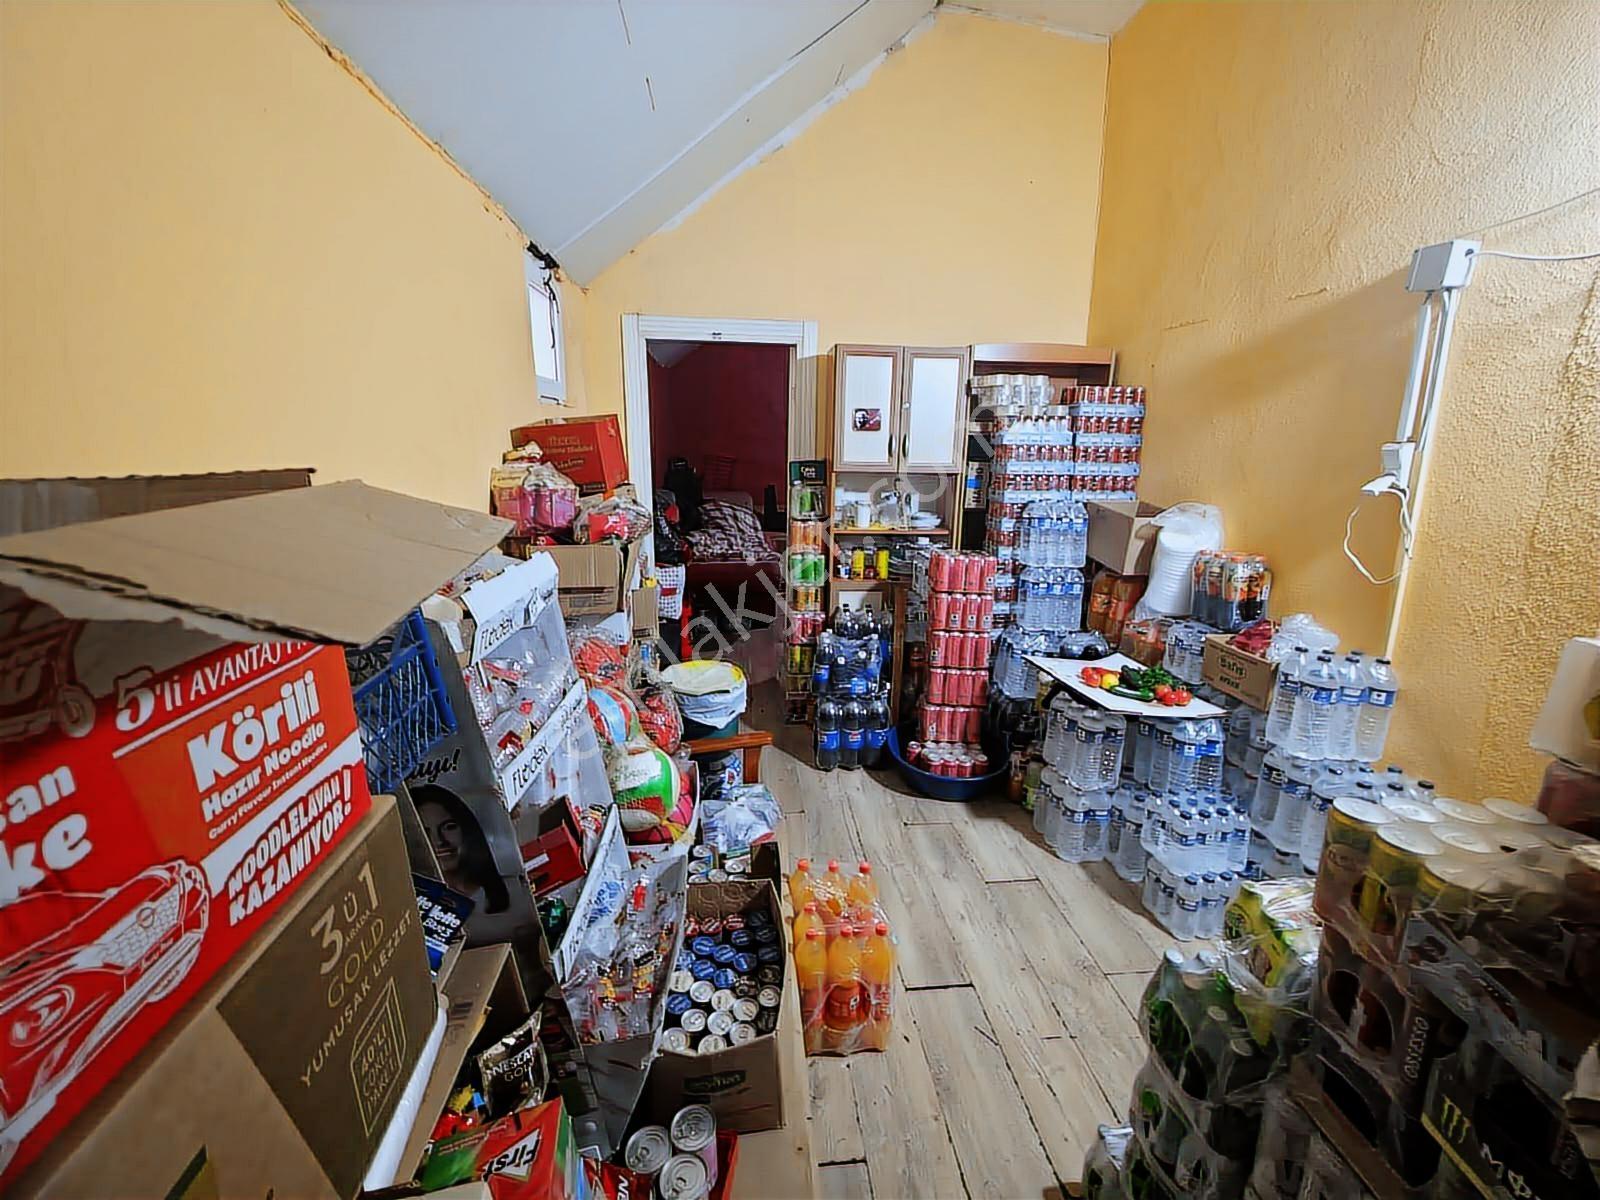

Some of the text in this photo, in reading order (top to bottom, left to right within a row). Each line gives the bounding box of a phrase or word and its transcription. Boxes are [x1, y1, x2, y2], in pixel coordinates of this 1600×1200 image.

[115, 666, 183, 731] 5'li
[187, 670, 320, 792] Körili
[0, 766, 76, 833] an
[229, 776, 340, 900] NOODLELAYAN
[311, 904, 344, 975] 3
[358, 862, 378, 910] 1
[328, 918, 384, 1008] GOLD
[301, 909, 411, 1088] YUMUŞAK LEZZET
